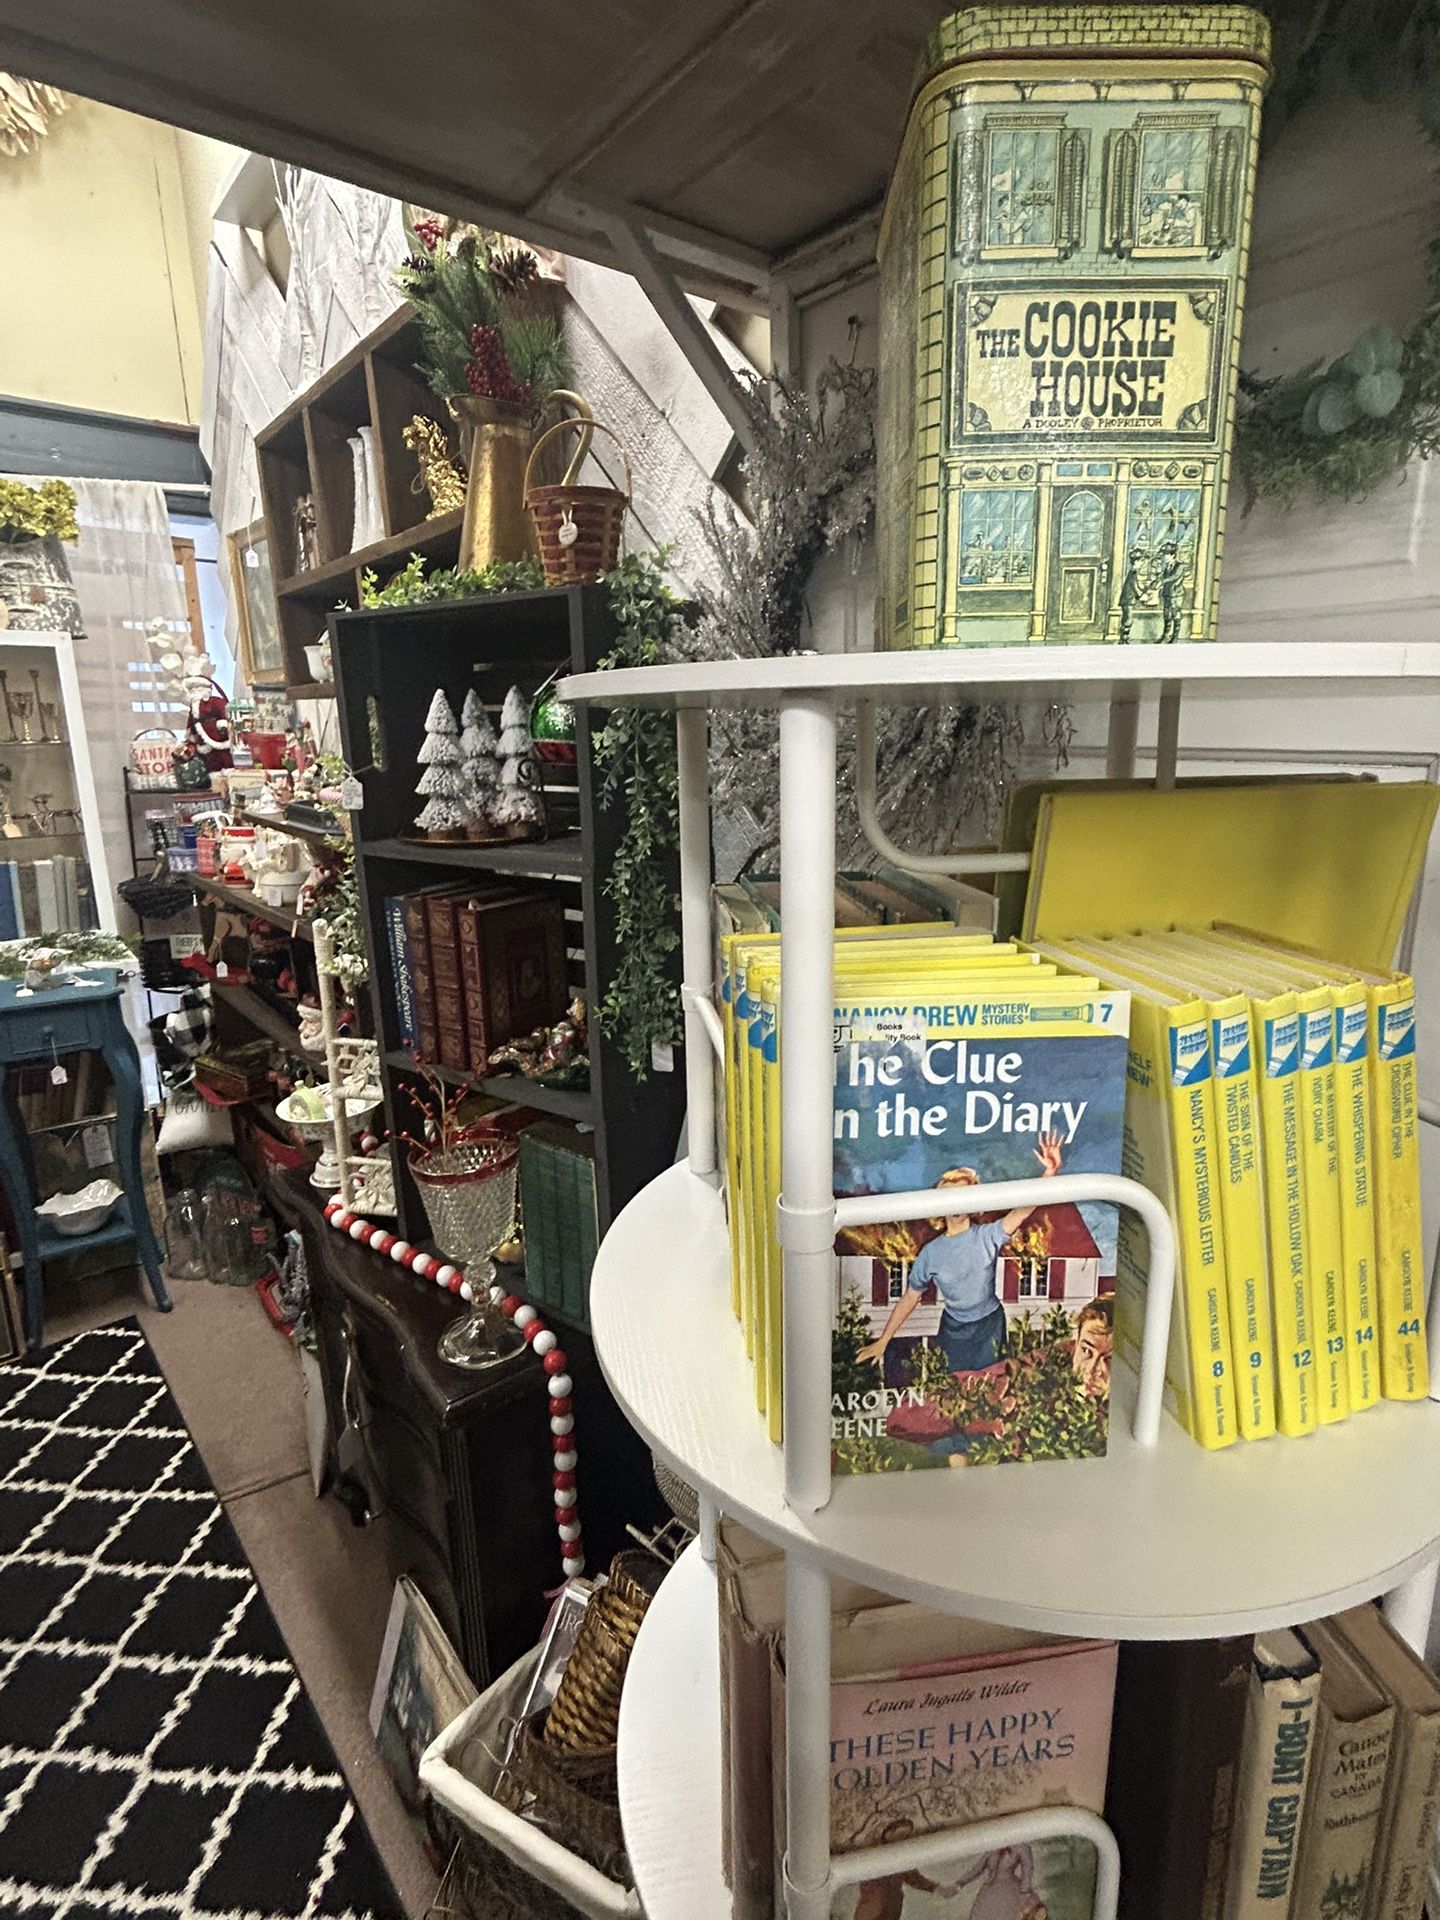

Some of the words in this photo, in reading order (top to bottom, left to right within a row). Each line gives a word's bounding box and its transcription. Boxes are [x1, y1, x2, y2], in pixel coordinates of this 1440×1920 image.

[976, 328, 1021, 358] THE
[1024, 299, 1178, 359] COOKIE
[1030, 358, 1167, 417] HOUSE
[135, 762, 174, 775] STOP
[393, 907, 407, 960] William
[981, 1003, 1030, 1015] MYSTERY
[1100, 1003, 1114, 1023] 7
[876, 1023, 903, 1031] Books
[921, 1040, 1023, 1085] Clue
[1240, 1079, 1249, 1103] THE
[1352, 1066, 1363, 1091] THE
[1283, 1081, 1294, 1105] THE
[874, 1093, 948, 1138] the
[964, 1089, 1089, 1144] Diary
[1190, 1088, 1207, 1145] NANCY'S
[1226, 1083, 1240, 1133] TWISTED
[1240, 1104, 1252, 1131] SIGN
[1241, 1133, 1252, 1147] OF
[1284, 1105, 1297, 1165] MESSAGE
[1353, 1091, 1366, 1165] WHISPERING
[1228, 1135, 1242, 1184] CANDLES
[1286, 1165, 1298, 1178] IN
[1194, 1146, 1213, 1223] MYSTERIOUS
[1288, 1180, 1300, 1203] THE
[1355, 1166, 1368, 1208] STATUE
[1288, 1203, 1303, 1251] HOLLOW
[1200, 1224, 1215, 1267] LETTER
[1290, 1252, 1304, 1278] OAK
[1355, 1325, 1374, 1345] 14
[1397, 1318, 1420, 1336] 44
[1326, 1335, 1344, 1355] 13
[1212, 1360, 1224, 1378] 8
[1249, 1351, 1262, 1369] 9
[1292, 1348, 1312, 1369] 12
[831, 1387, 926, 1412] AROLYN
[831, 1418, 888, 1439] EENE
[862, 1698, 915, 1716] Laura
[919, 1687, 976, 1710] Ingalls
[979, 1679, 1033, 1701] Wilder
[948, 1707, 1063, 1745] HAPPY
[832, 1752, 954, 1790] OLDEN
[969, 1734, 1076, 1770] YEARS
[1257, 1794, 1301, 1899] CAPTAIN
